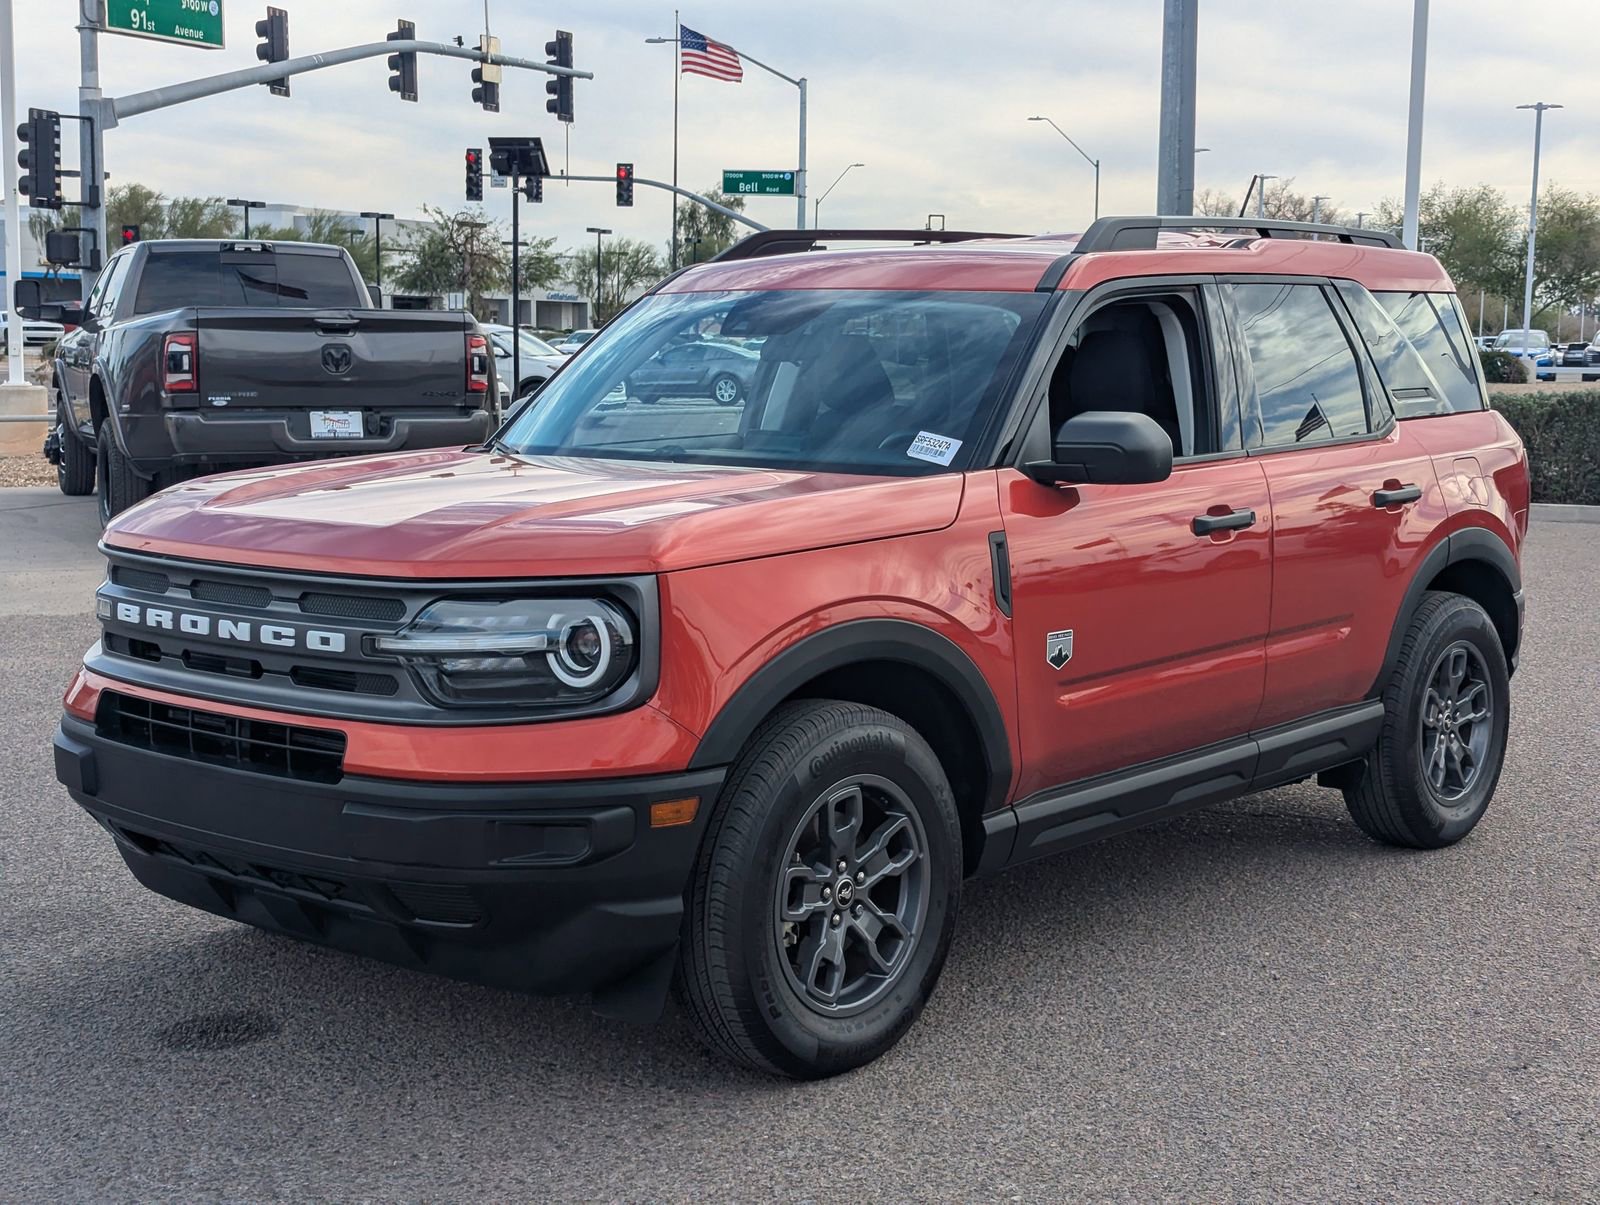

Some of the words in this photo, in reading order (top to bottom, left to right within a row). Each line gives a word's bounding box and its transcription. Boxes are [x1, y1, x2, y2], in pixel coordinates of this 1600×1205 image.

[131, 8, 155, 31] 91st
[174, 25, 204, 39] Avenue
[739, 182, 758, 192] Bell
[117, 602, 346, 653] BRONCO
[809, 731, 886, 778] Continental
